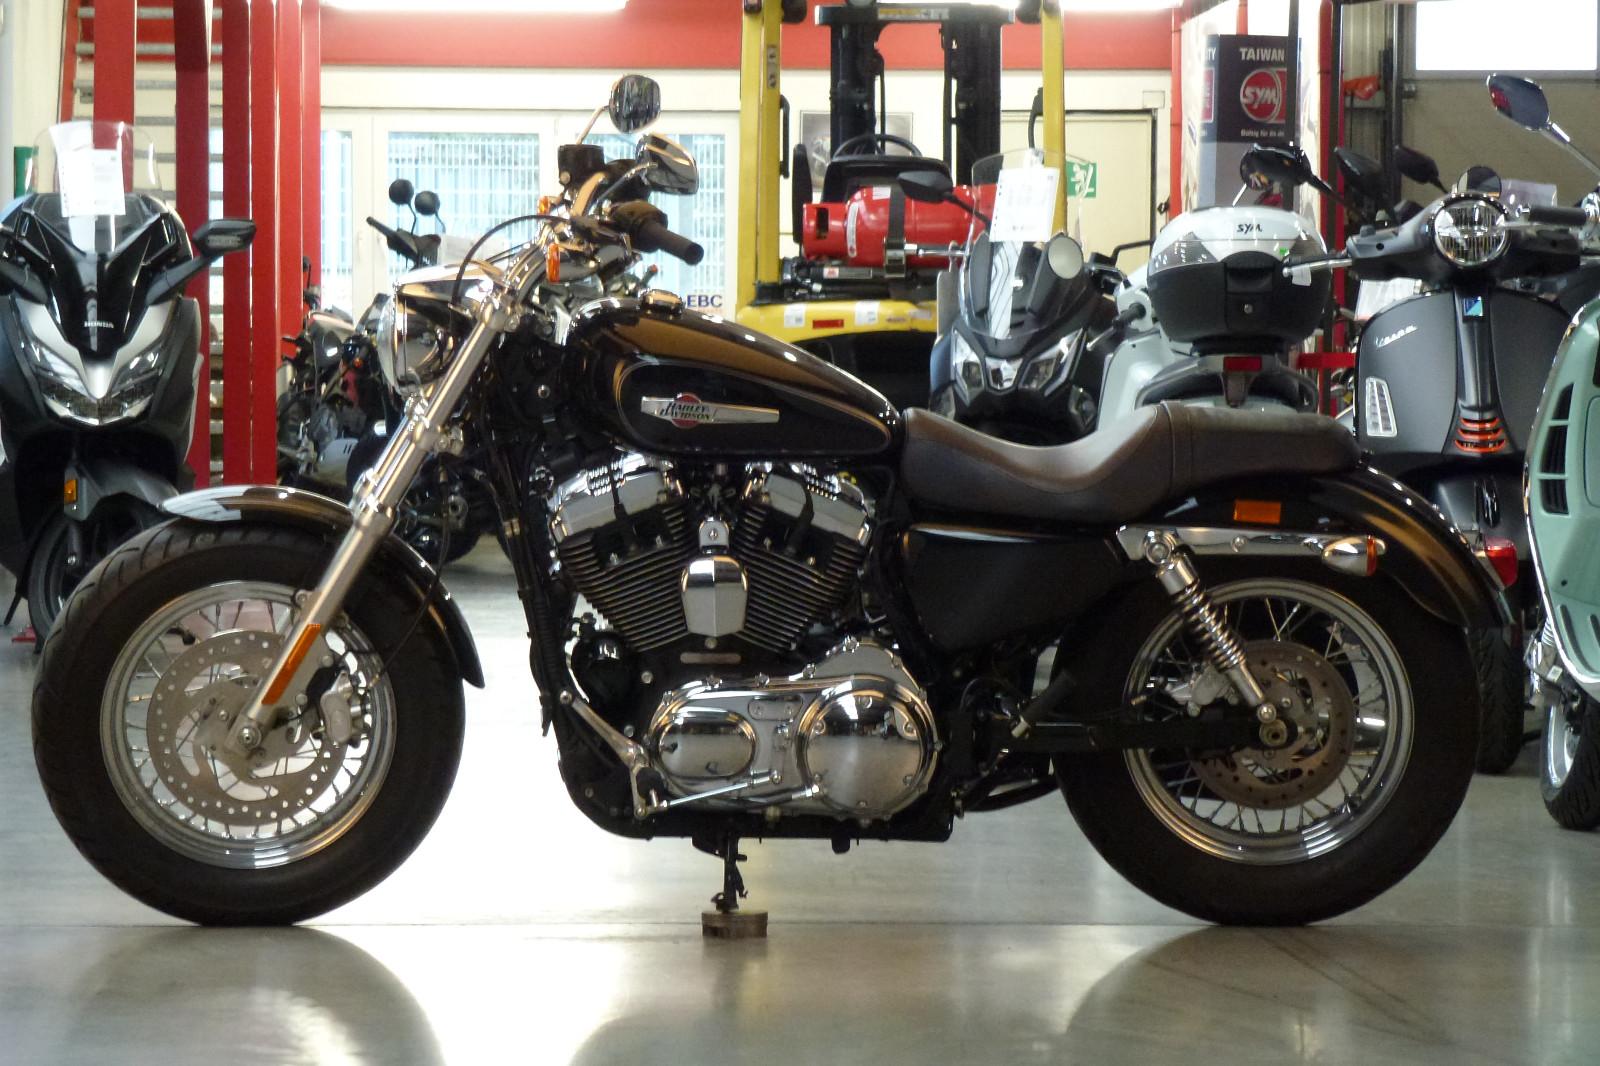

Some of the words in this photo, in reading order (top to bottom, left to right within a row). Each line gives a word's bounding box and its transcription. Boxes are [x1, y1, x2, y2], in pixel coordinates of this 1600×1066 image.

[1240, 47, 1285, 61] TAIWAN
[1241, 86, 1277, 109] SYM
[686, 294, 722, 308] EBC
